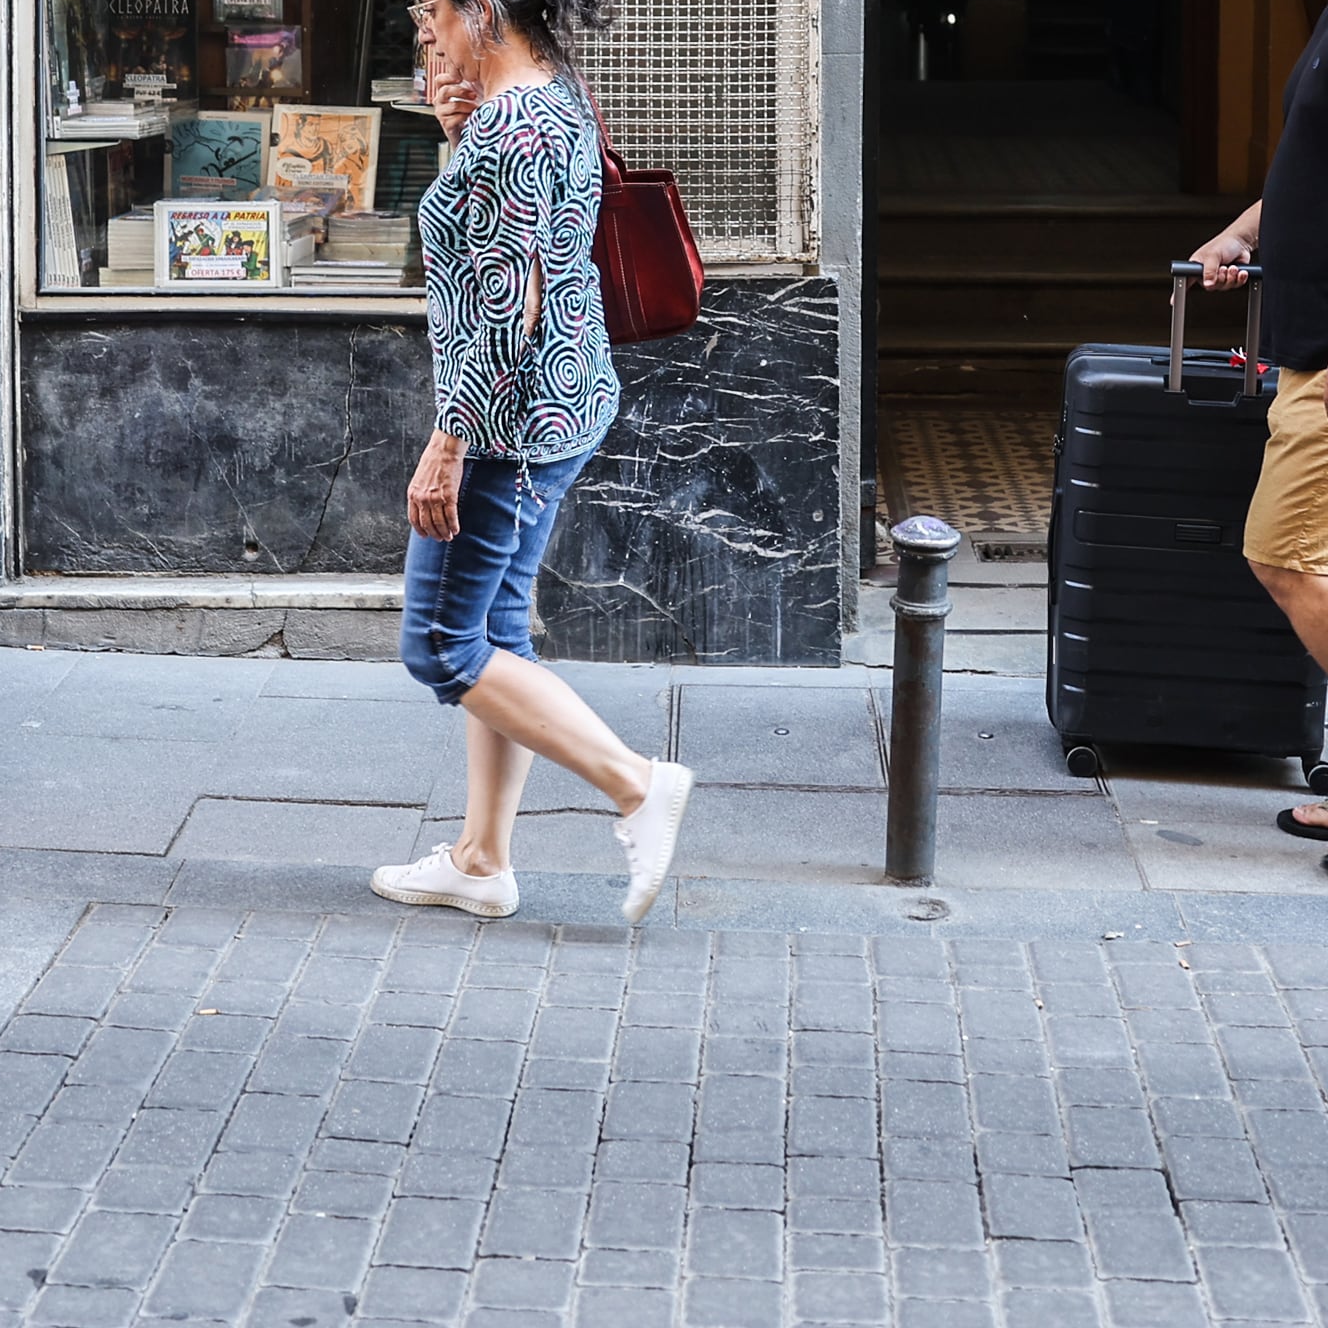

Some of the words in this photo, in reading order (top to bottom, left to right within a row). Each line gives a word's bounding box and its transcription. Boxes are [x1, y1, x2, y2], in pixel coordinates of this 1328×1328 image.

[126, 74, 166, 83] CLEOPATRA
[170, 212, 210, 220] REGRESO
[234, 212, 267, 220] PATRIA
